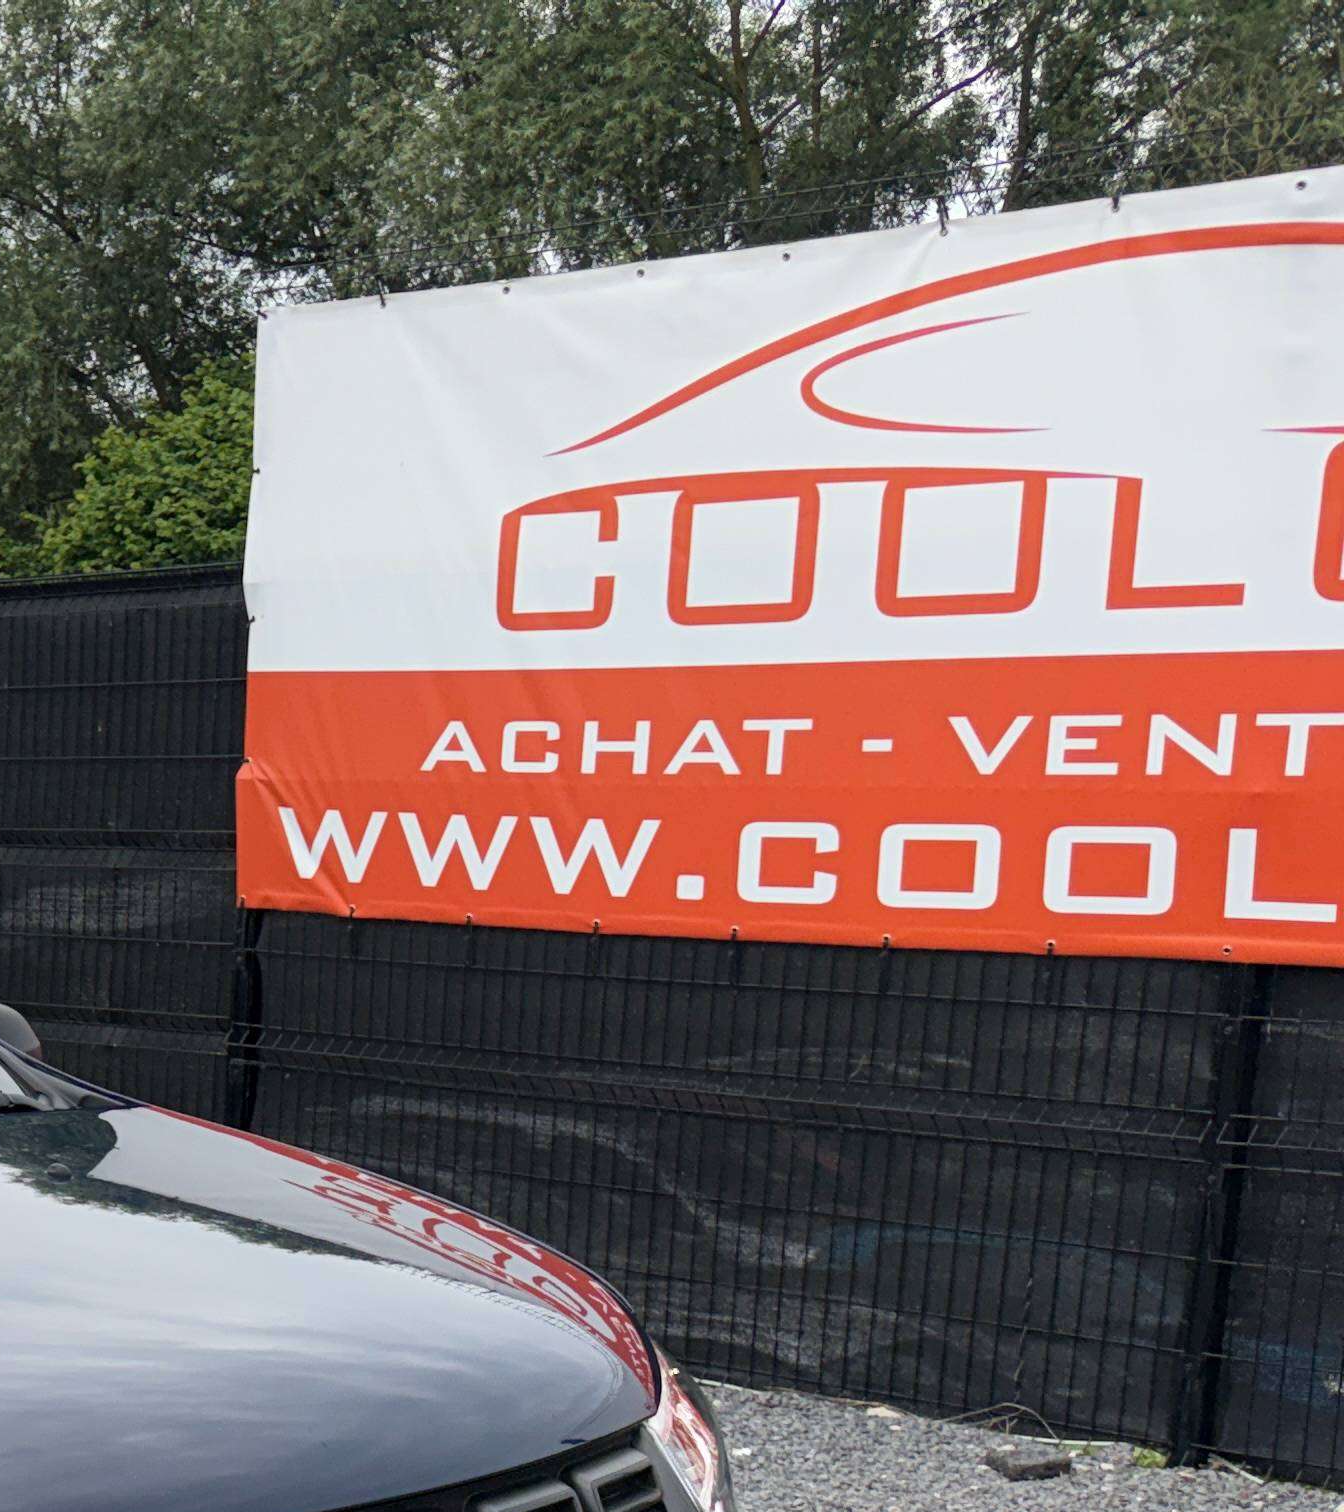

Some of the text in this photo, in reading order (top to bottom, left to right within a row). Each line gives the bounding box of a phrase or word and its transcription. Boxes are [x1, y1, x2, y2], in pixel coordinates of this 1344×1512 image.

[497, 442, 1344, 631] COOL
[420, 718, 813, 775] ACHAT
[949, 712, 1344, 777] VENT
[278, 806, 1338, 923] WWW.COOL
